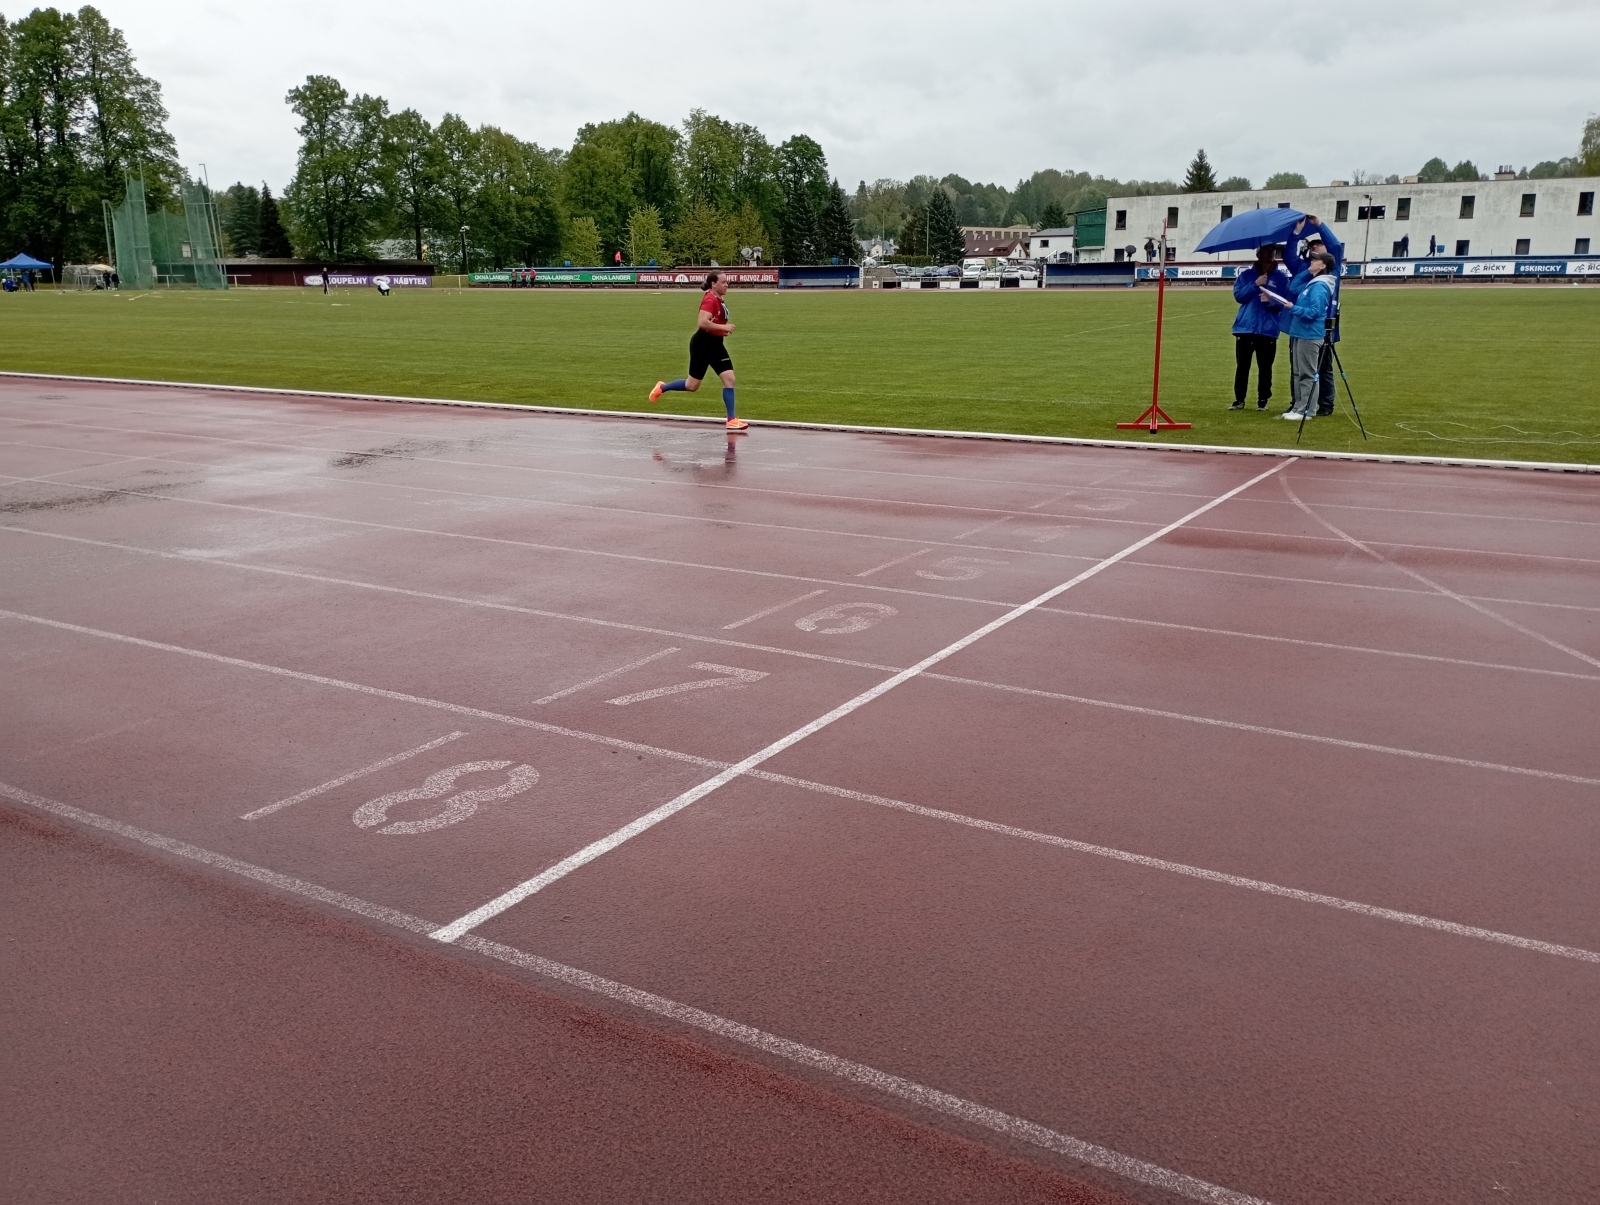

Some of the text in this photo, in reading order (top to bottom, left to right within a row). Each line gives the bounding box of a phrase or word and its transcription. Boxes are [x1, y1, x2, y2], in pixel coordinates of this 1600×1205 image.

[393, 276, 428, 285] NÁBYTEK
[915, 556, 1010, 581] 5
[794, 602, 899, 634] 6
[604, 660, 771, 706] 7
[352, 759, 541, 835] 8
